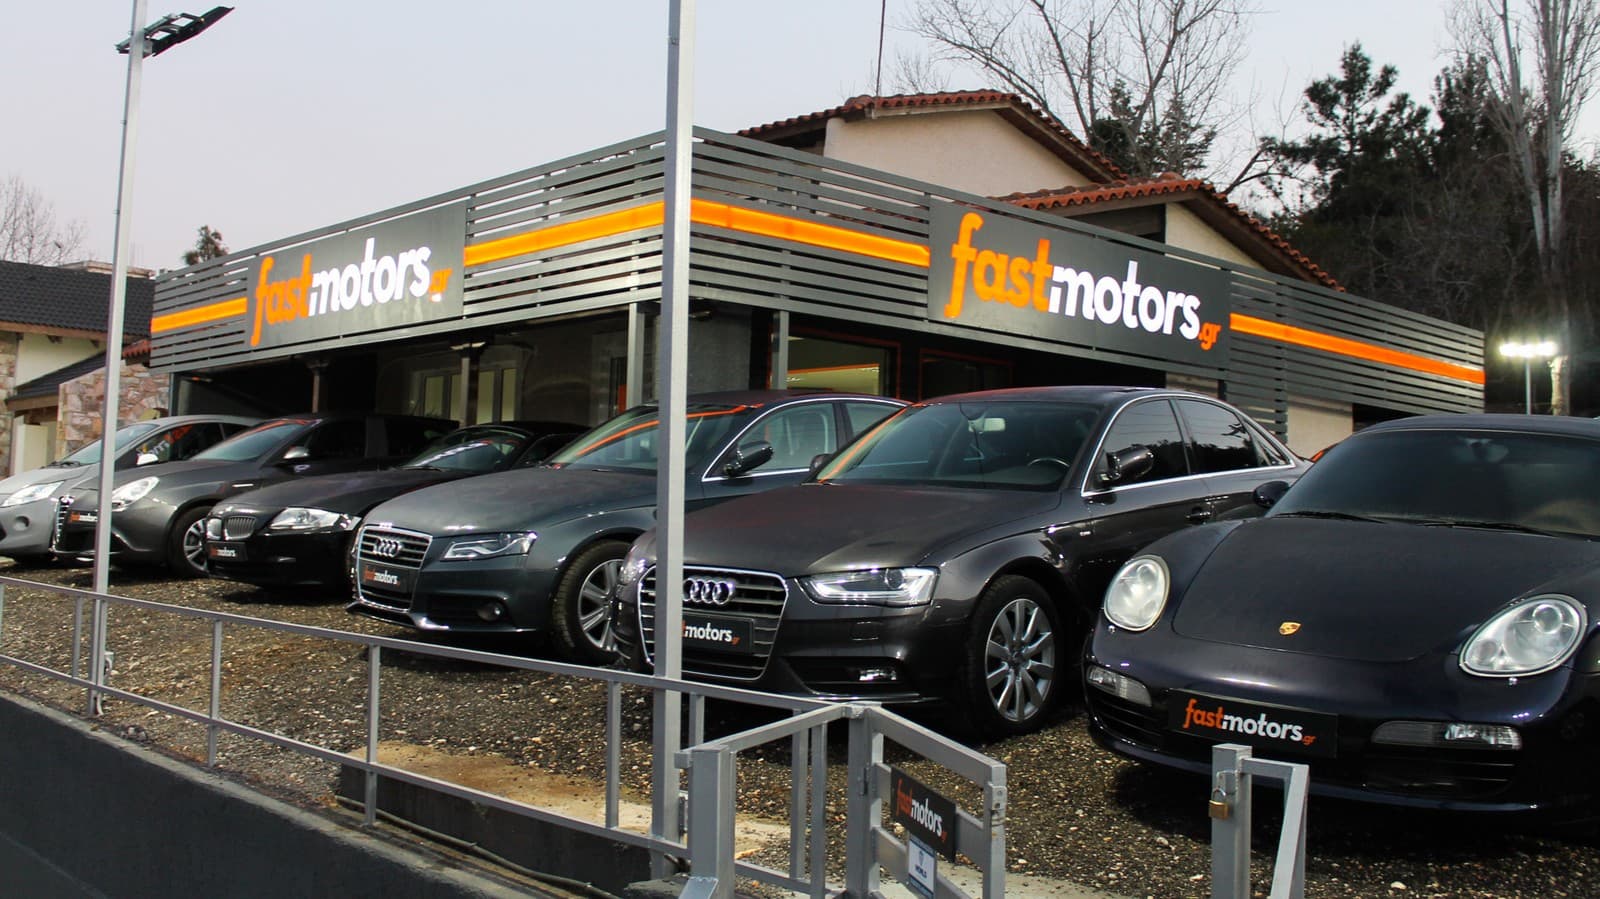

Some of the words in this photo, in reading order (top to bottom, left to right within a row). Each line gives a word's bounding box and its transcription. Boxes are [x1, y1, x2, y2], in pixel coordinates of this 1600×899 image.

[250, 237, 453, 347] fastmotors.gr
[943, 211, 1222, 350] fastmotors.gr
[1183, 698, 1317, 746] fastmotors.gr
